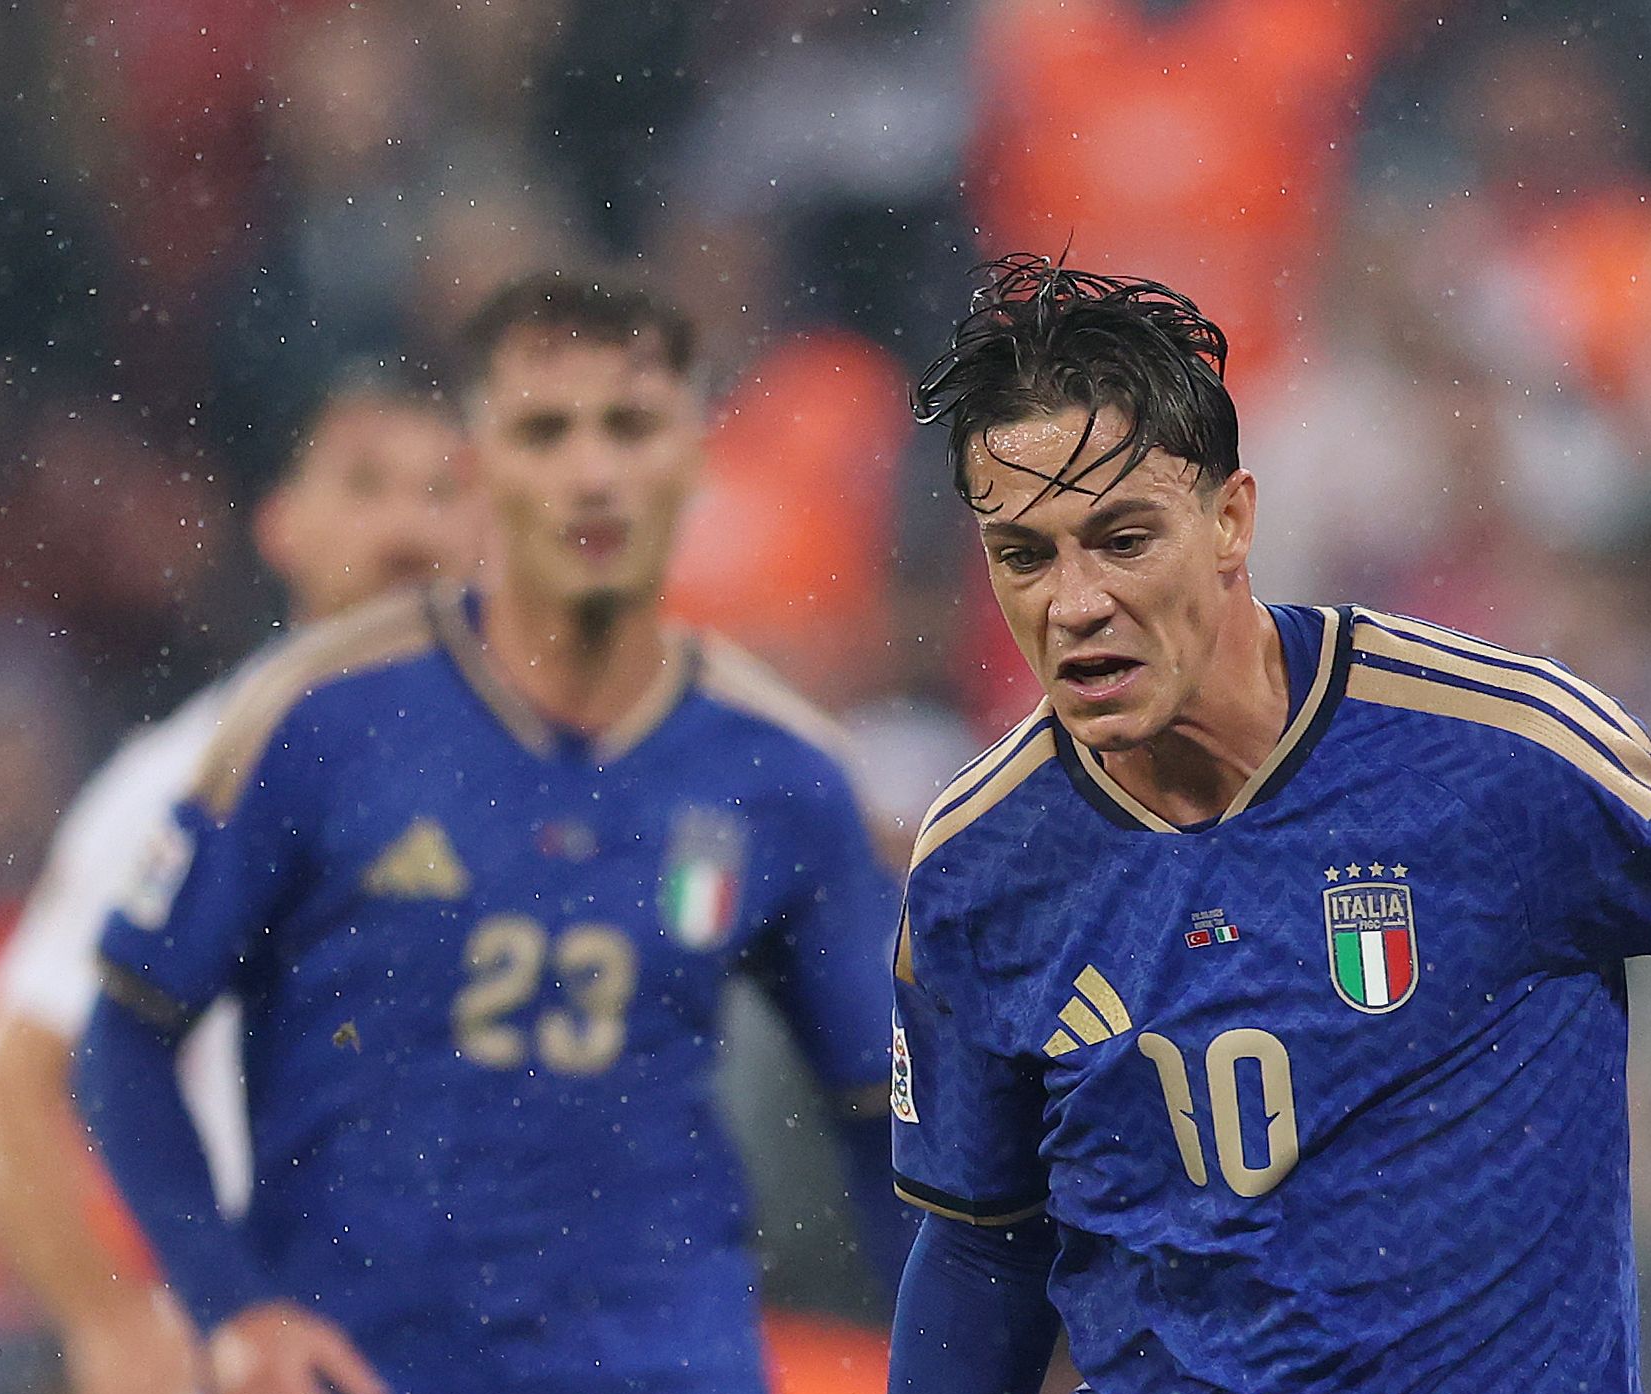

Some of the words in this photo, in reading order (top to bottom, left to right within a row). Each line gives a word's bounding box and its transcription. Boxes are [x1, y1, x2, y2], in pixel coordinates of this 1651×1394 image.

[1331, 893, 1405, 921] ITALIA
[453, 912, 640, 1077] 23
[1137, 1028, 1299, 1198] 10
